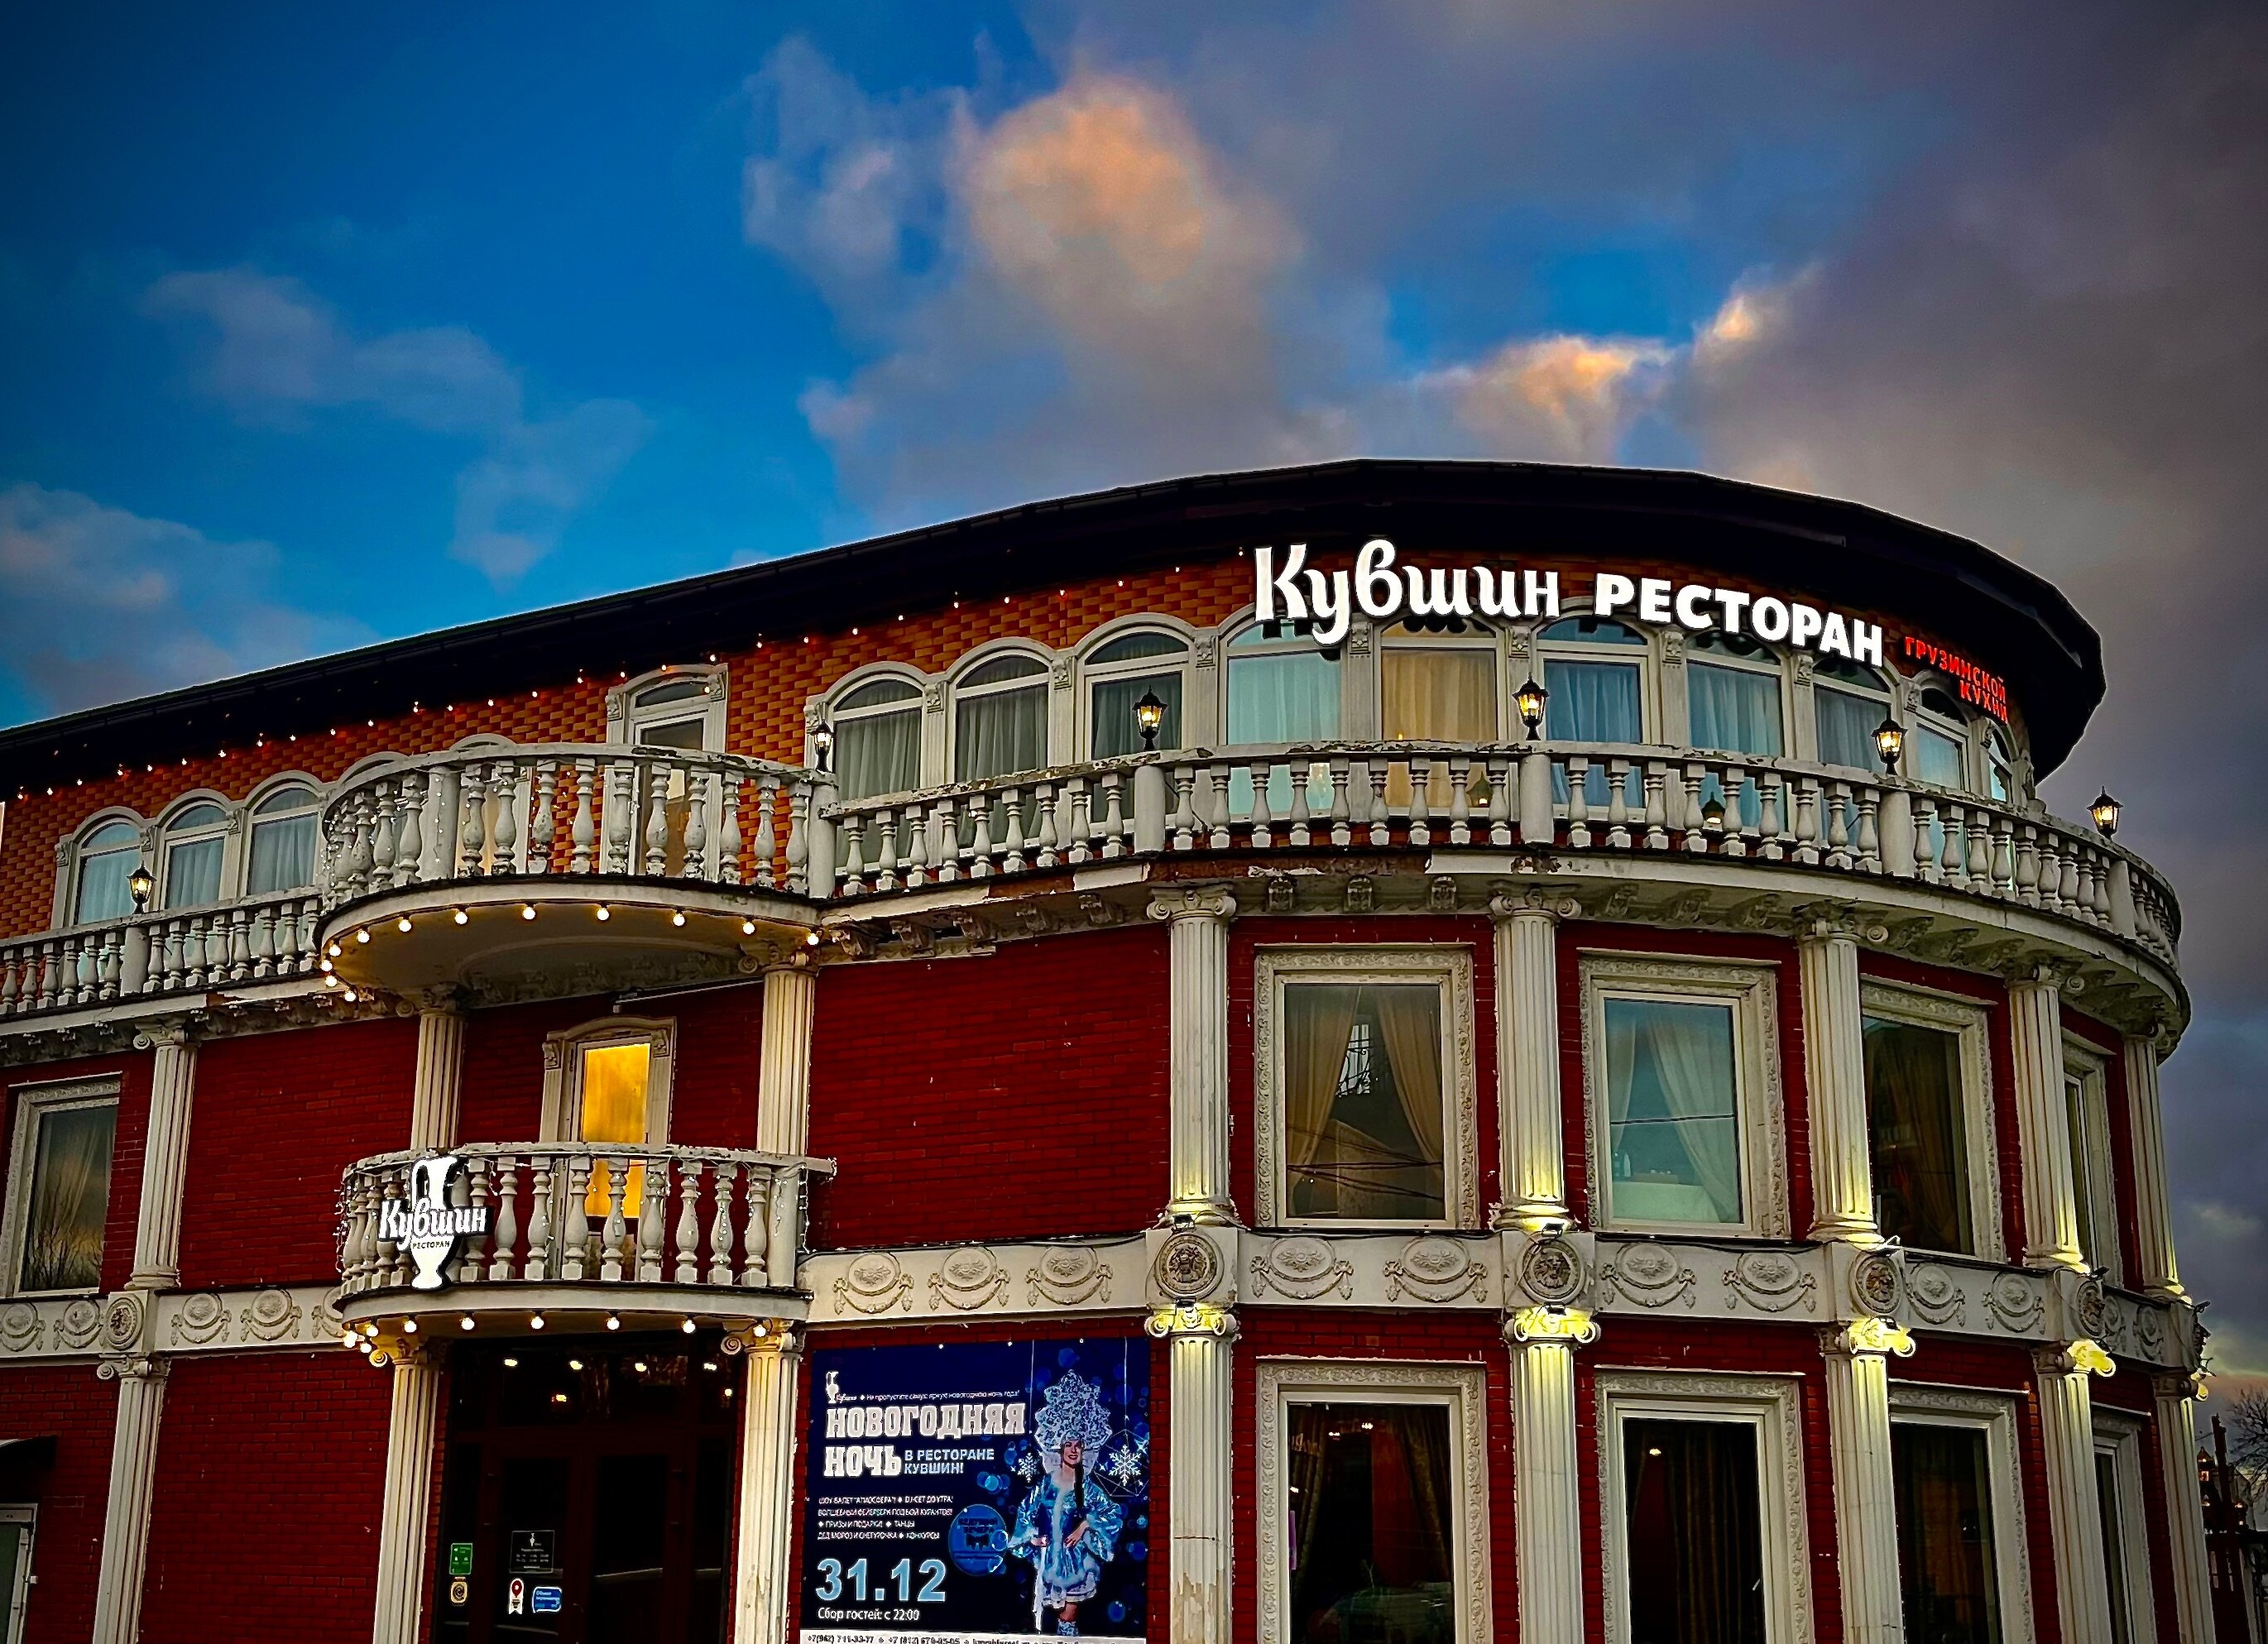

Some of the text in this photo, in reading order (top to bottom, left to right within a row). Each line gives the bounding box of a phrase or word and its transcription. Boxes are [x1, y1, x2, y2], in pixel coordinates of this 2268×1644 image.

[1254, 539, 1882, 668] Кувшин РЕСТОРАН
[1905, 636, 2006, 704] ГРУЗИНСКОЙ
[1959, 679, 2008, 724] КУХНИ
[378, 1198, 487, 1251] Кувшин
[412, 1240, 450, 1249] РЕСТОРАН
[826, 1403, 1026, 1440] НОВОГОДНЯЯ
[823, 1445, 902, 1478] НОЧЬ
[904, 1449, 995, 1461] В РЕСТОРАНЕ
[904, 1462, 964, 1474] КУВШИН!
[815, 1558, 947, 1602] 31.12
[818, 1607, 920, 1622] Сбор гостей: с 22:00
